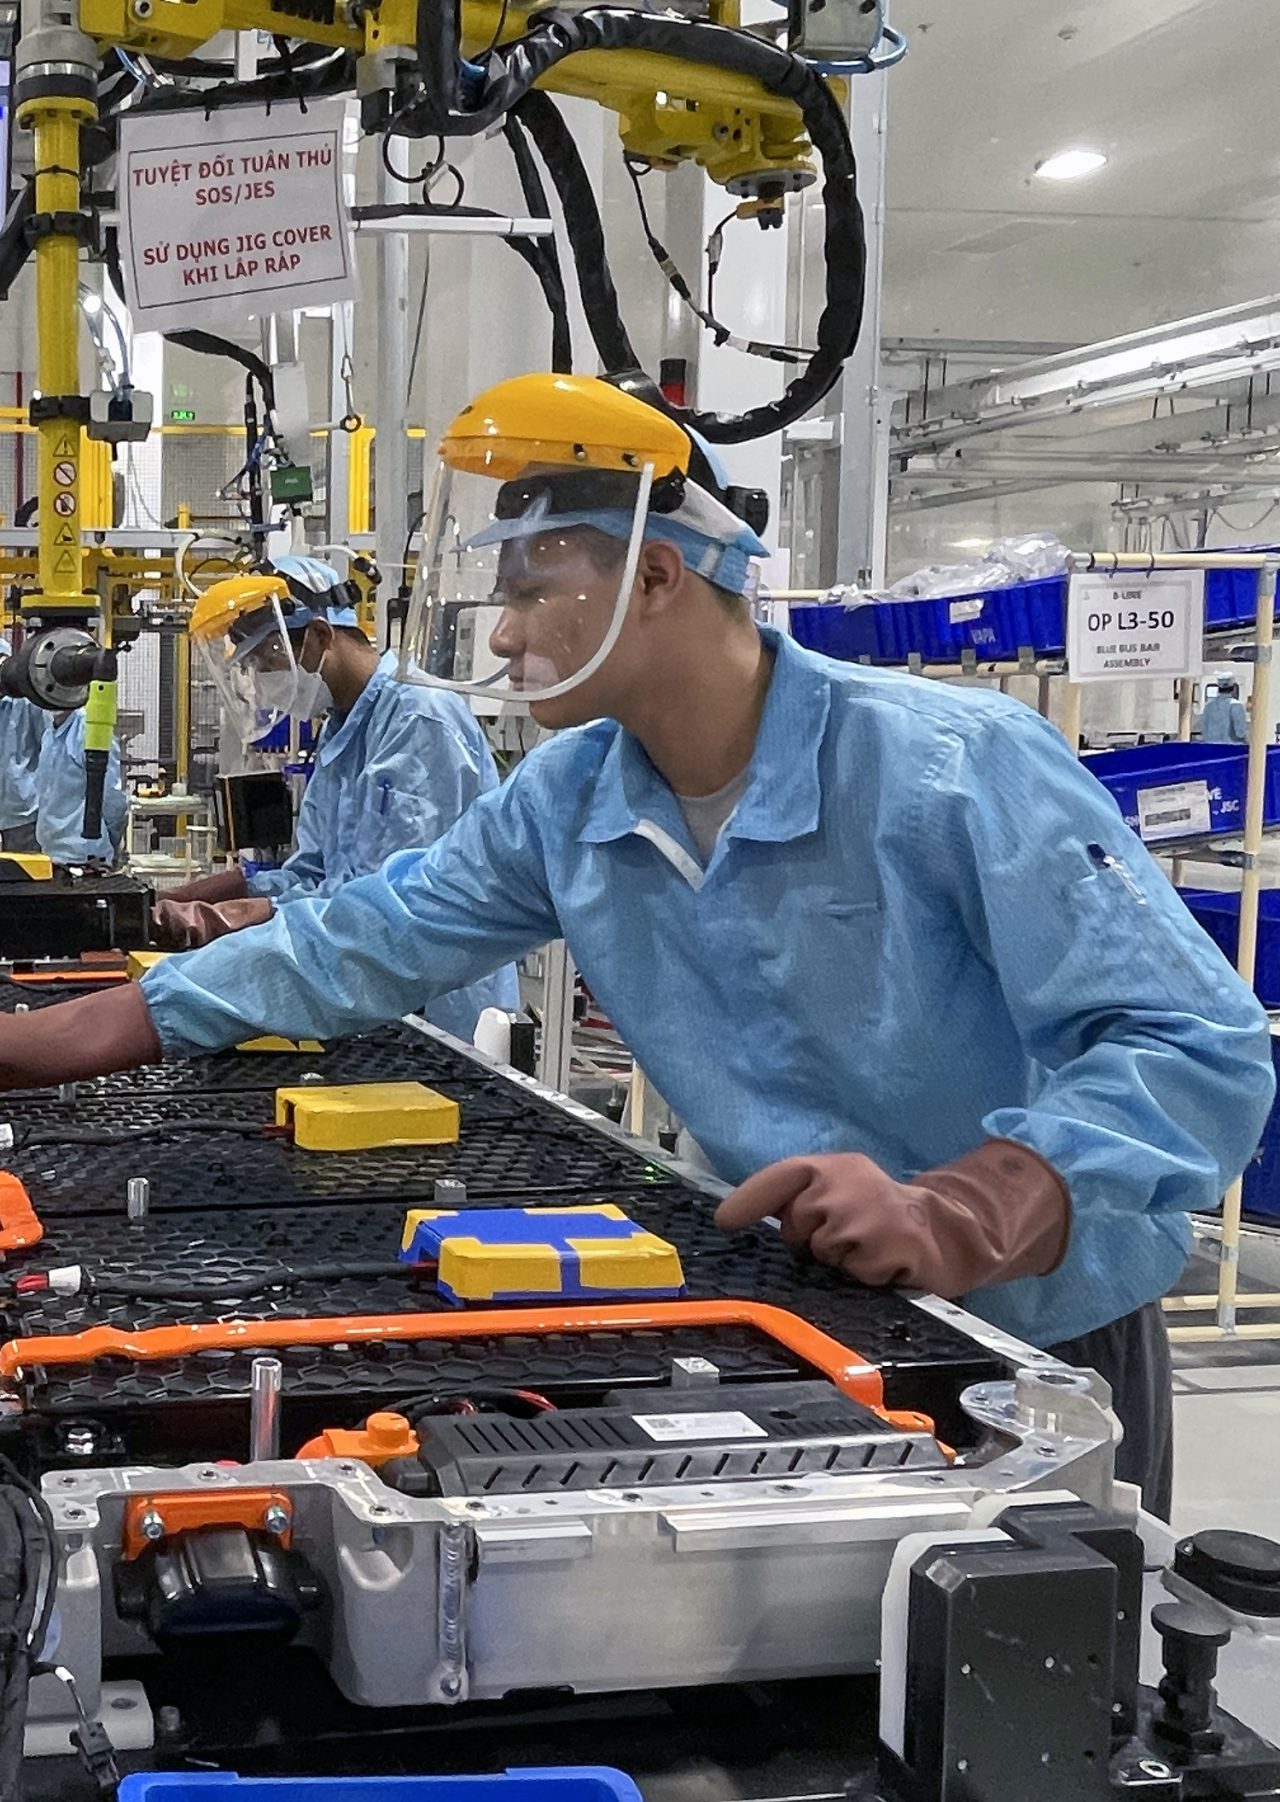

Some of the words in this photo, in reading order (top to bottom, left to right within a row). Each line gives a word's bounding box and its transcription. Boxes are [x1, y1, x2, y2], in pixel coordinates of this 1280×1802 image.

[133, 159, 192, 187] TUYỆT
[199, 152, 235, 179] ĐỐI
[241, 149, 290, 174] TUÂN
[296, 142, 332, 168] THỦ
[195, 181, 275, 205] SOS/JES
[143, 240, 170, 265] SỬ
[176, 238, 230, 263] DỤNG
[236, 233, 266, 253] JIG
[272, 224, 332, 247] COVER
[182, 265, 218, 286] KHI
[265, 250, 301, 274] RÁP
[1088, 613, 1112, 631] OP
[1118, 610, 1175, 630] L3-50
[1096, 645, 1117, 654] BLUE
[1119, 643, 1137, 653] BUS
[1140, 643, 1160, 652] BAR
[1103, 658, 1151, 668] ASSEMBLY
[1220, 800, 1240, 813] JSC
